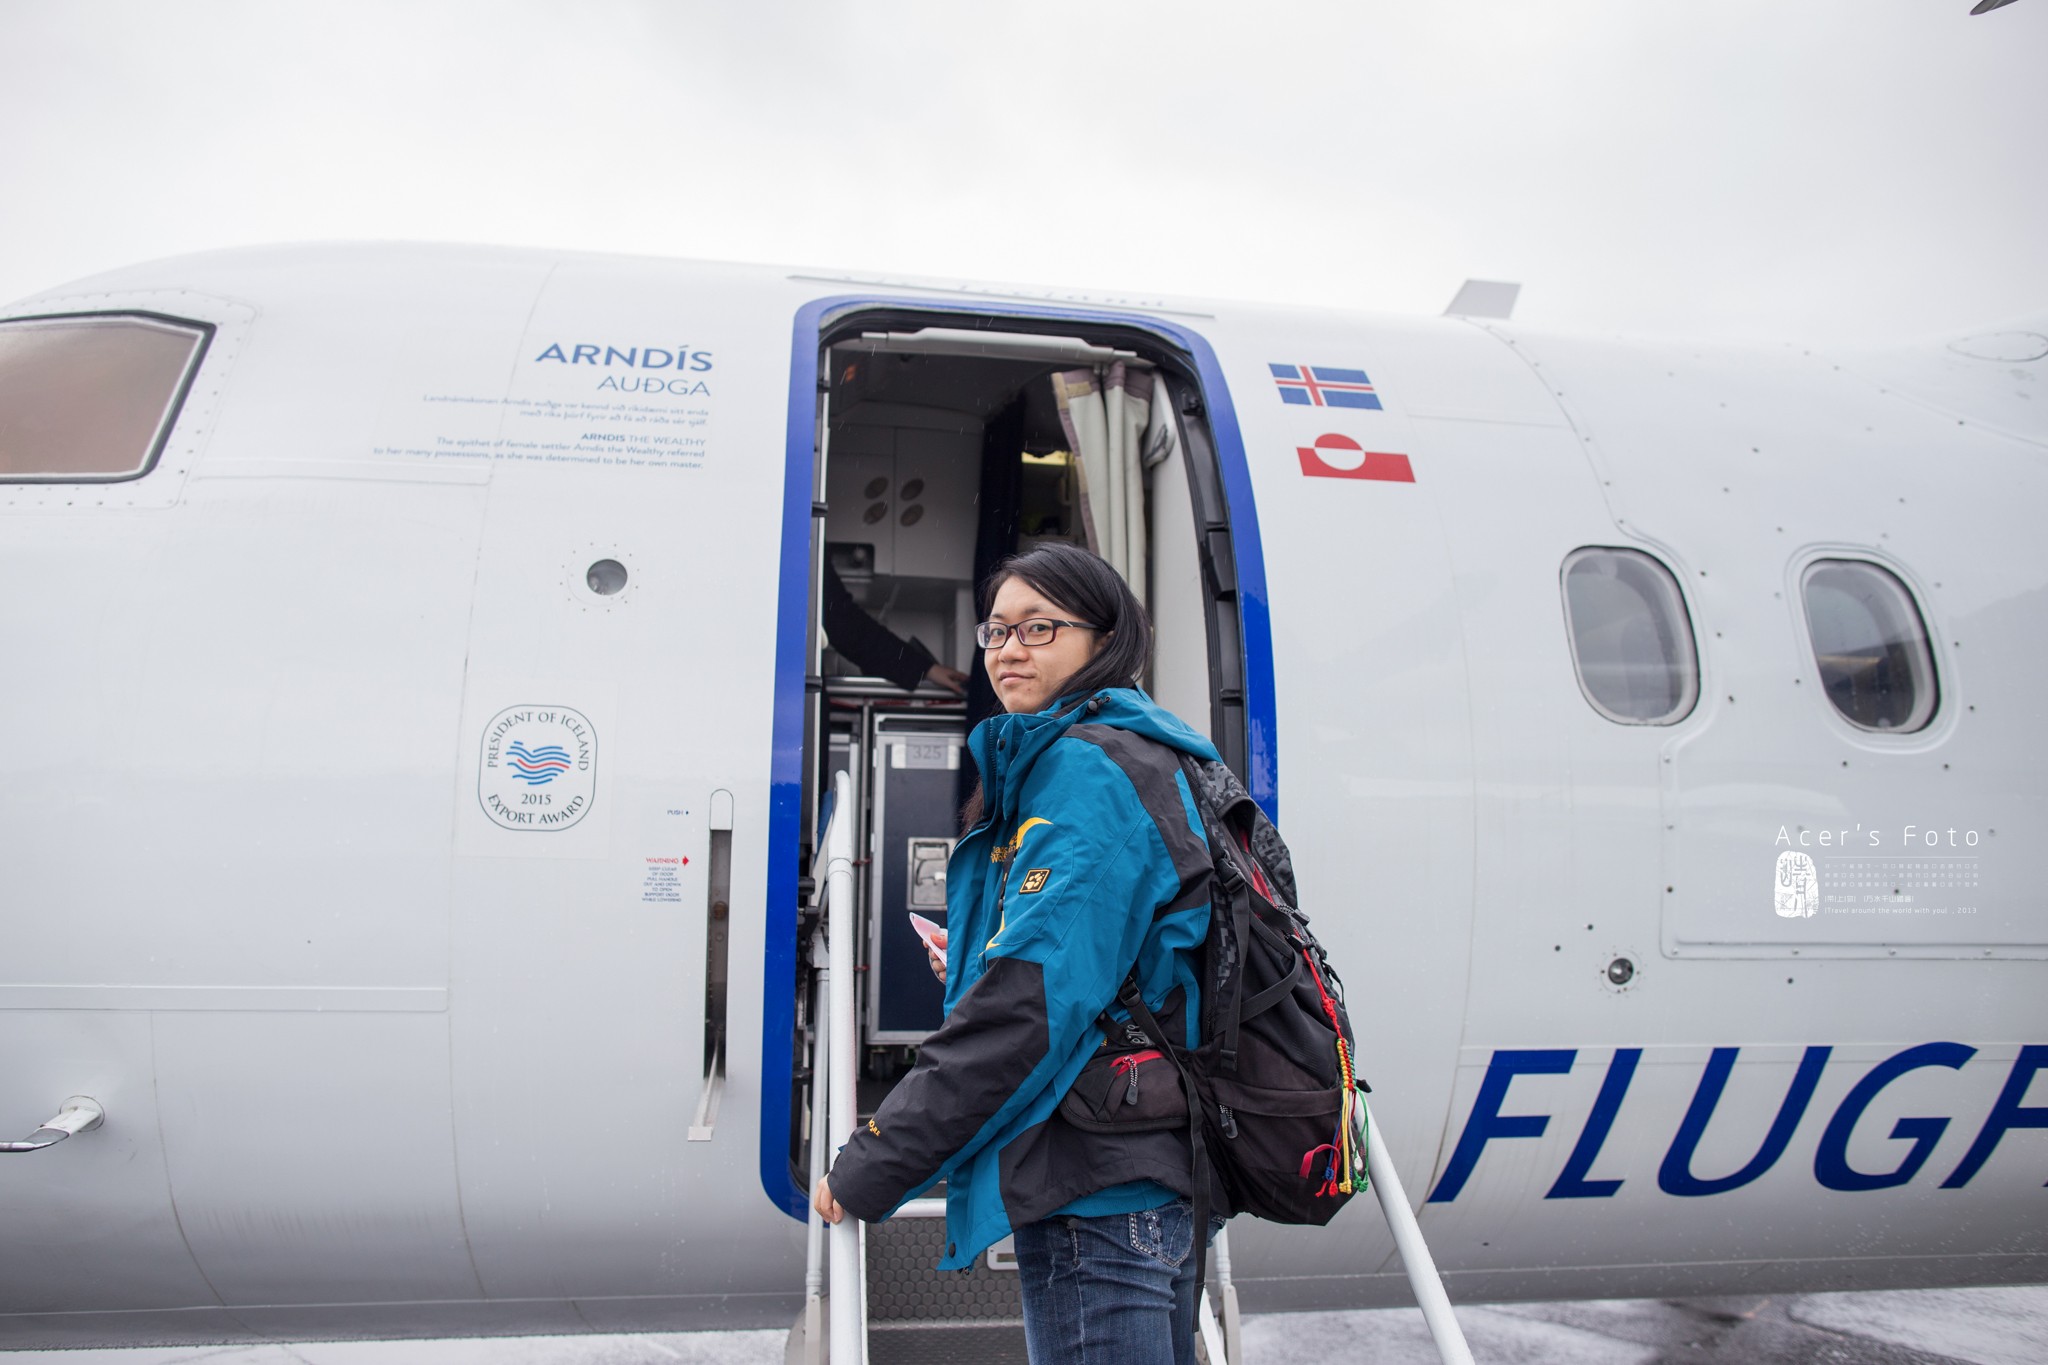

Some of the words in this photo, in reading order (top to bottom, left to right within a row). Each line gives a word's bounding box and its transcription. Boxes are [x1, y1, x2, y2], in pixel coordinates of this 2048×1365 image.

[535, 342, 713, 372] ARNDÍS
[596, 376, 711, 397] AUÐGA
[581, 433, 626, 443] ARNDIS
[654, 436, 706, 446] WEALTHY
[487, 711, 534, 768] PRESIDENT
[538, 712, 557, 723] OF
[560, 714, 590, 771] ICELAND
[912, 745, 942, 760] 325
[488, 794, 536, 824] EXPORT
[539, 795, 584, 824] AWARD
[521, 793, 552, 806] 2015
[1425, 1041, 2048, 1203] FLUGF
